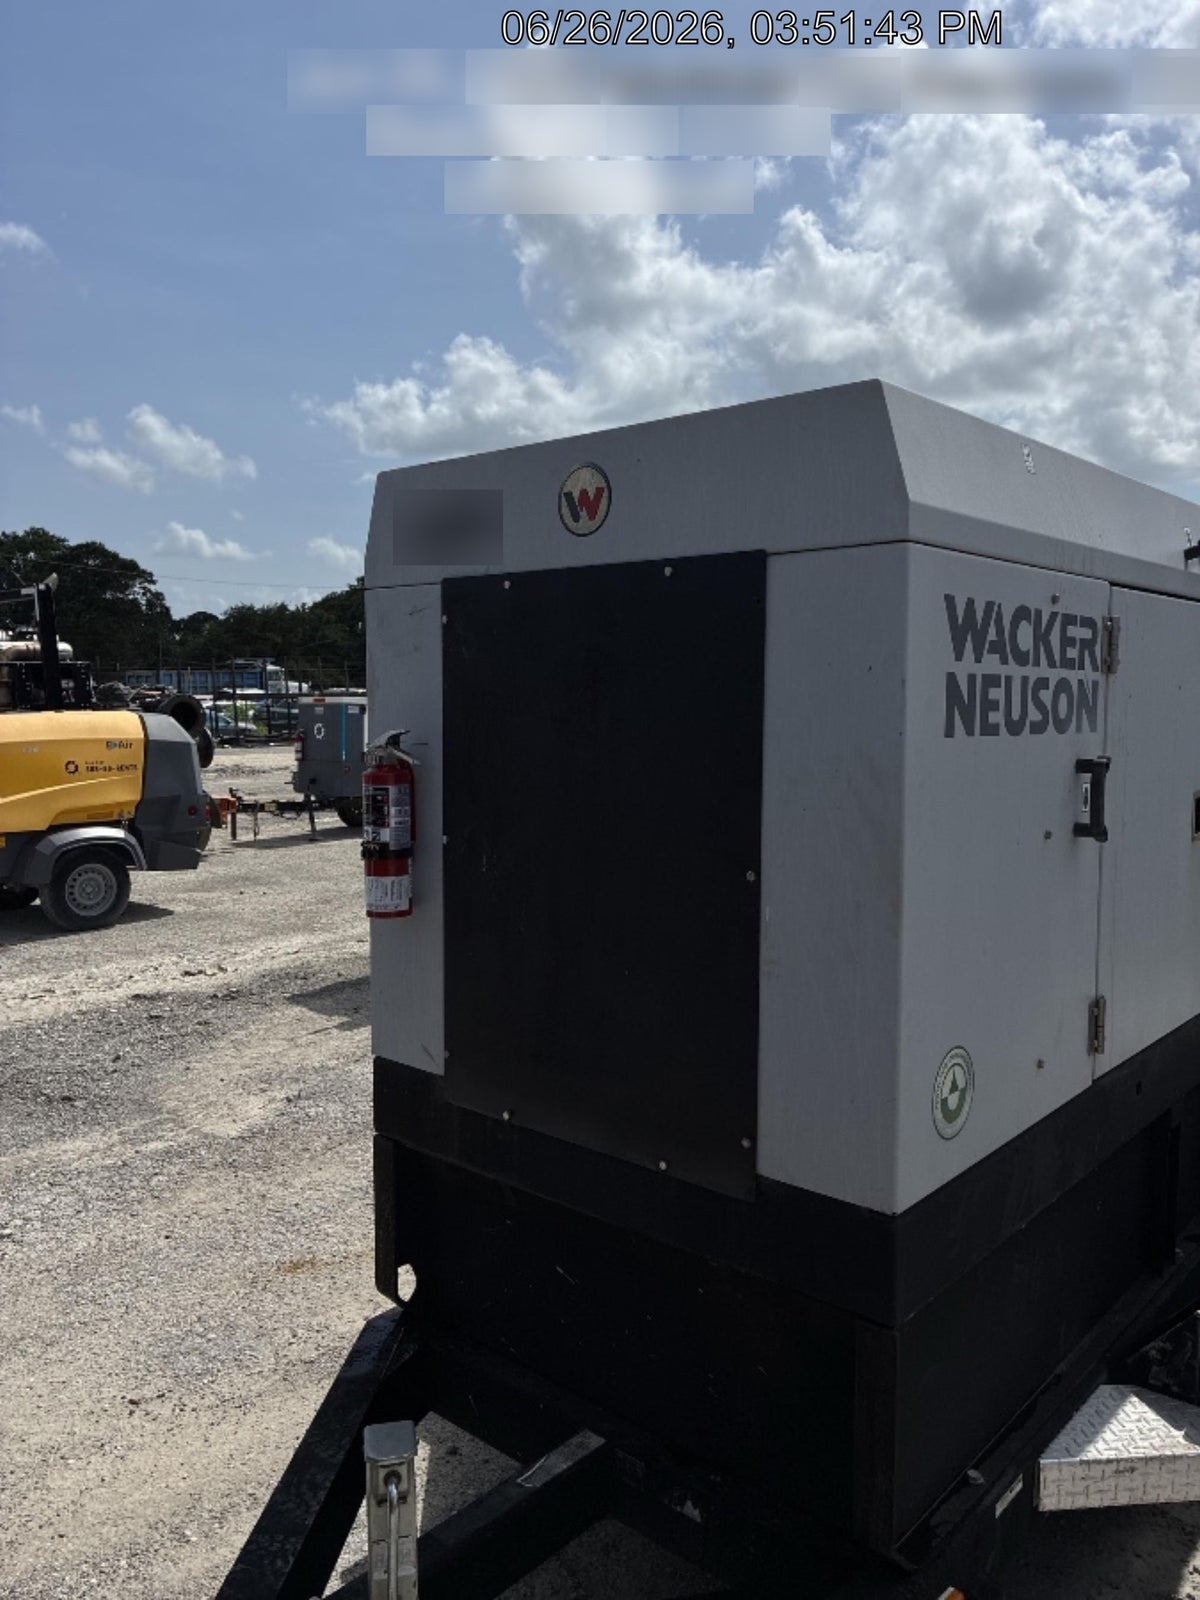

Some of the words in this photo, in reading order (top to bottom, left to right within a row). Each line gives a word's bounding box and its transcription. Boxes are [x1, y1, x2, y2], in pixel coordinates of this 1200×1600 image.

[563, 487, 605, 523] W
[944, 593, 1100, 672] WACKER
[944, 671, 1100, 738] NEUSON
